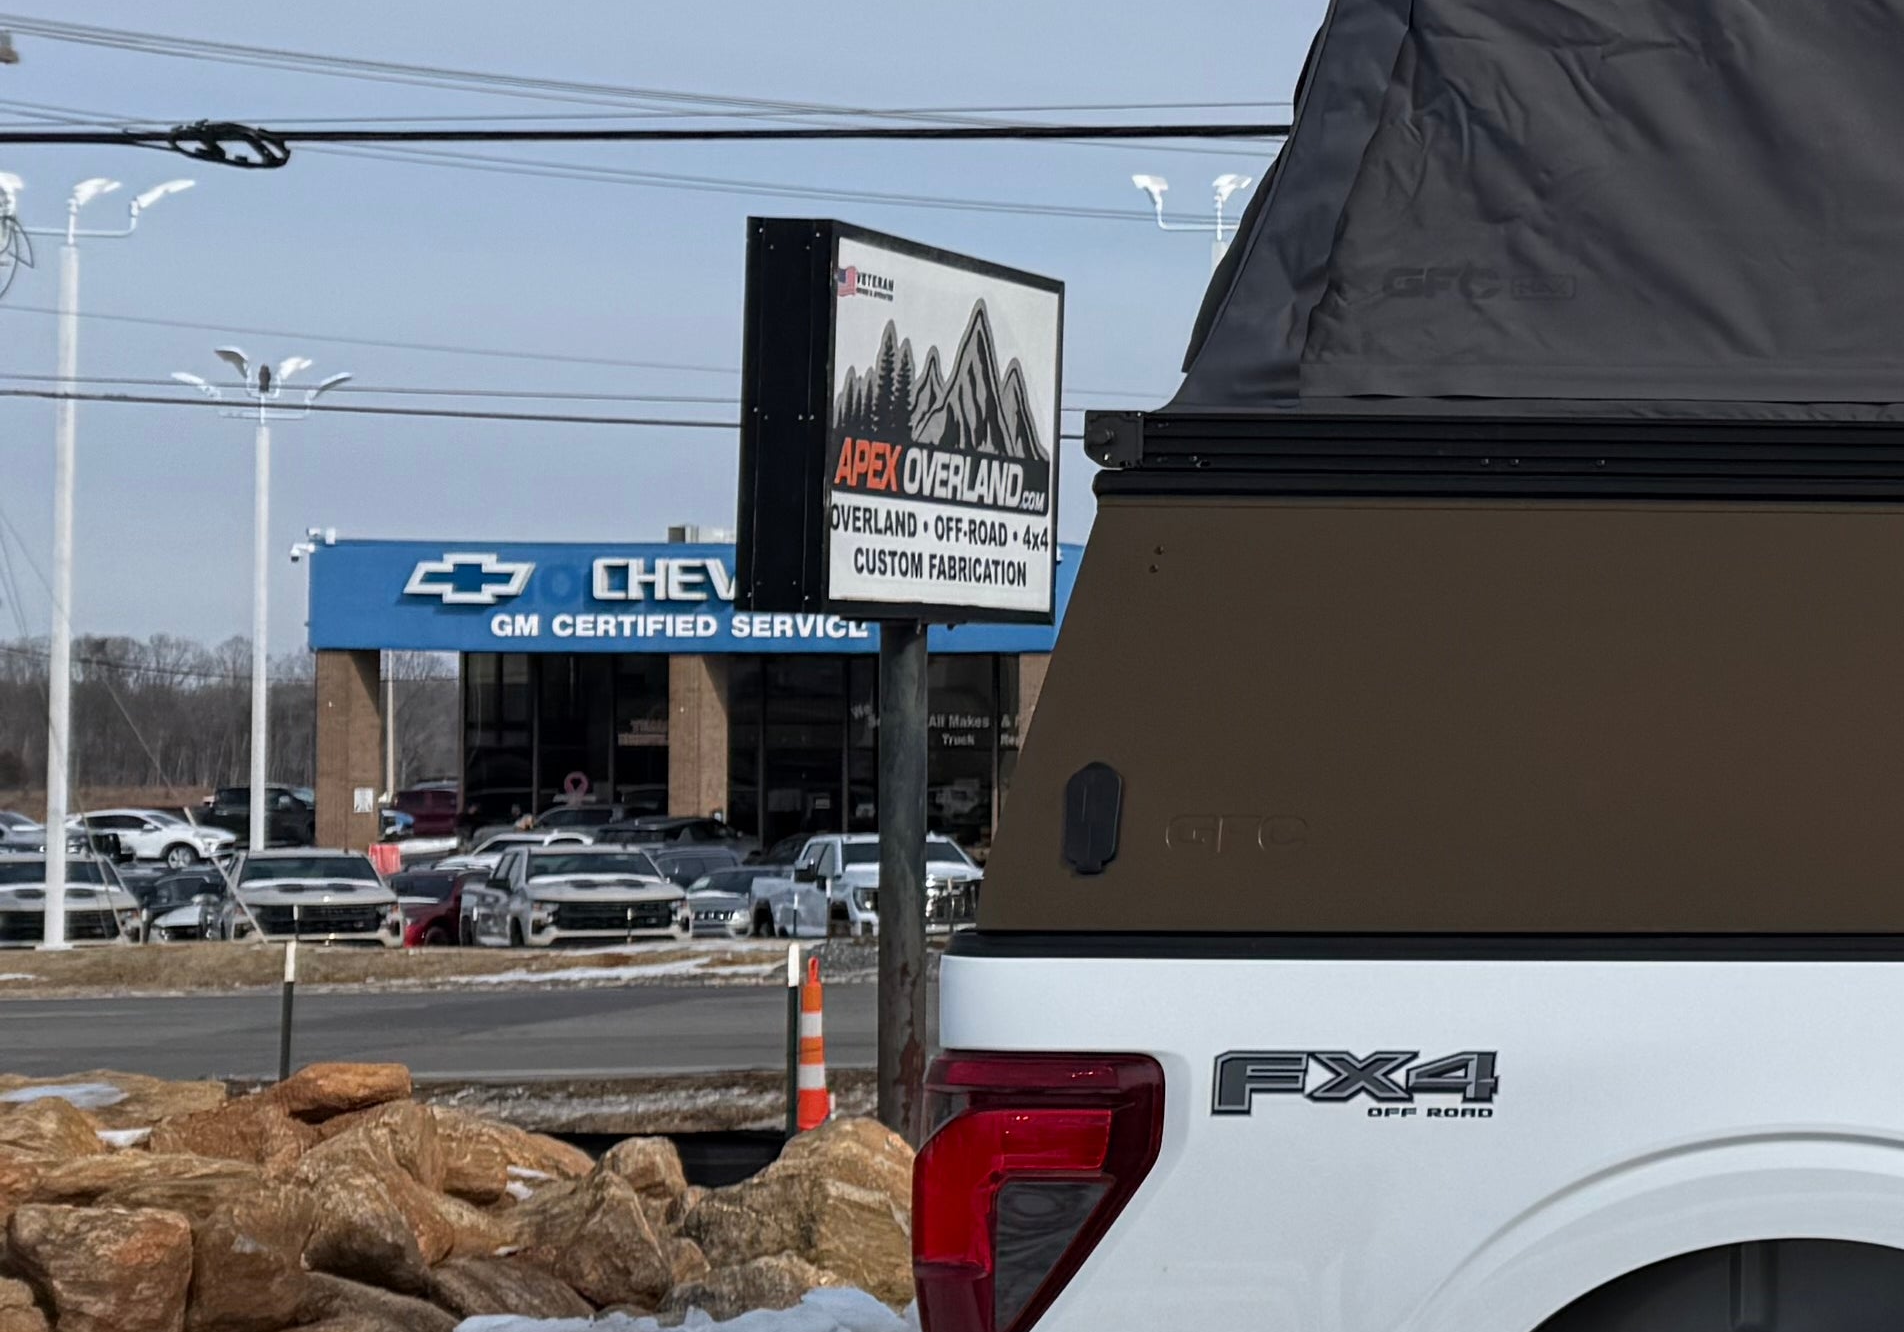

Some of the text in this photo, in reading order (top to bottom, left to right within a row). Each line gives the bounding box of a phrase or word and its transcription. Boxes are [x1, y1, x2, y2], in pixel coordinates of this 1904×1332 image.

[834, 436, 902, 492] APEX
[831, 503, 917, 538] OVERLAND
[934, 514, 1008, 547] OFF-ROAD
[854, 546, 1027, 587] CUSTOM FABRICATION
[490, 613, 540, 638] GM
[551, 613, 719, 638] CERTIFIED
[1210, 1049, 1500, 1117] FX4
[1367, 1107, 1494, 1118] OFF ROAD
